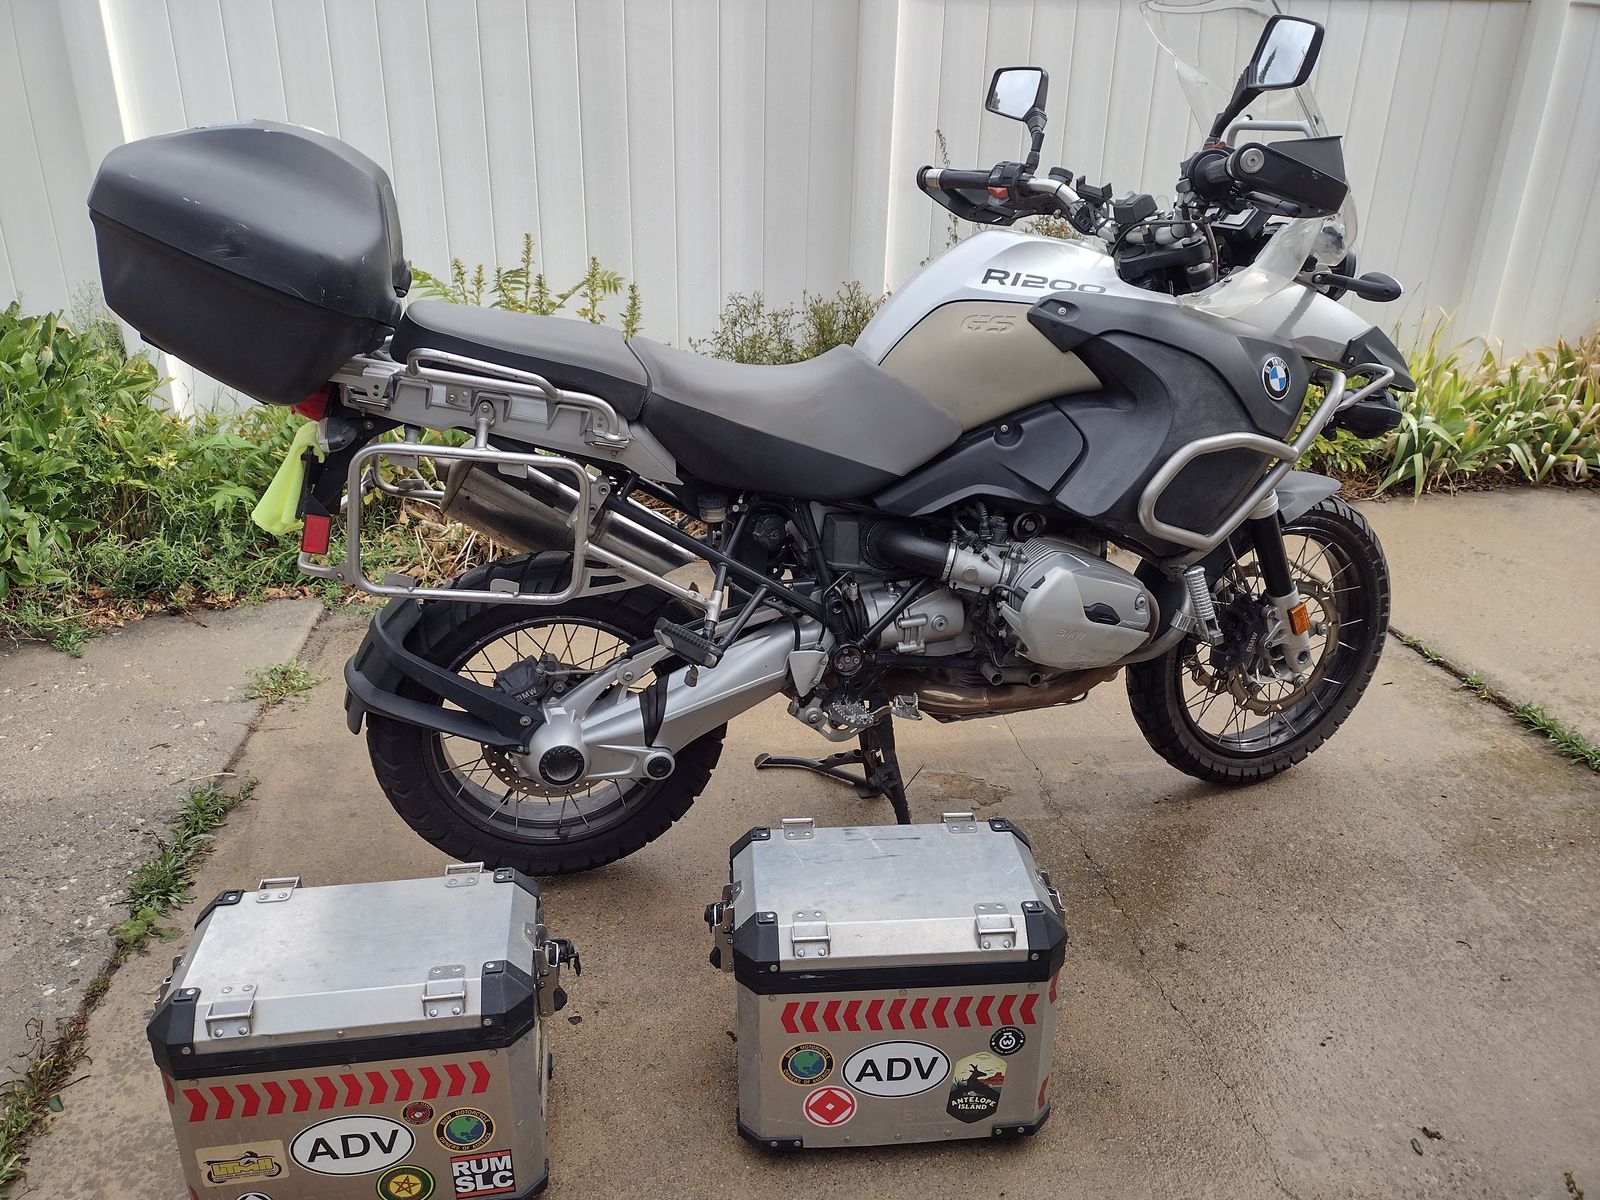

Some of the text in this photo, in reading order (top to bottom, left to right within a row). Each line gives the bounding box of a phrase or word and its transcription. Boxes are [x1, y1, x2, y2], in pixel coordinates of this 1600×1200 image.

[981, 268, 1107, 295] R1200
[960, 313, 1017, 334] GS
[1264, 358, 1288, 374] BMW
[1246, 631, 1259, 653] BMW
[800, 1044, 831, 1060] MOTORCYCLE
[854, 1056, 940, 1083] ADV
[951, 1096, 997, 1108] ANTELOPE
[439, 1114, 453, 1126] BMW
[455, 1109, 491, 1123] MOTORCYCLE
[307, 1129, 400, 1163] ADV
[439, 1132, 493, 1152] OWNERS OF AMERICA
[451, 1155, 512, 1177] RUM
[455, 1170, 514, 1193] SLC
